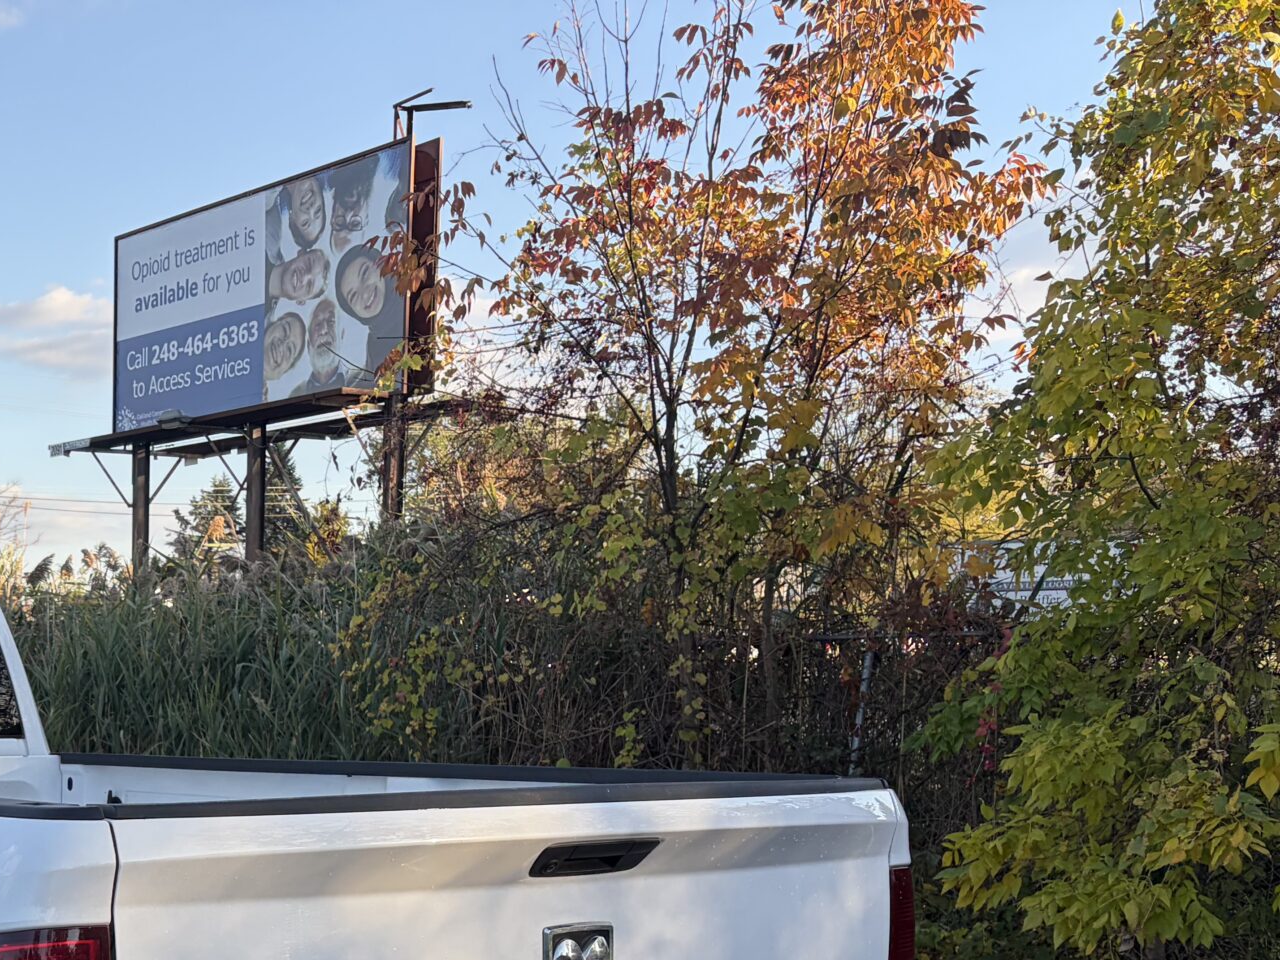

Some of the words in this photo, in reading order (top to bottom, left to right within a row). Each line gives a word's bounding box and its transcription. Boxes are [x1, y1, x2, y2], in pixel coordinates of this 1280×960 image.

[131, 250, 170, 283] Opioid
[175, 231, 240, 268] treatment
[244, 226, 255, 248] is
[134, 278, 199, 313] available
[202, 272, 221, 294] for
[225, 266, 251, 293] you
[126, 346, 149, 371] Call
[151, 320, 259, 365] 248-464-6363
[132, 380, 145, 398] to
[148, 371, 191, 395] Access
[194, 358, 251, 385] Services
